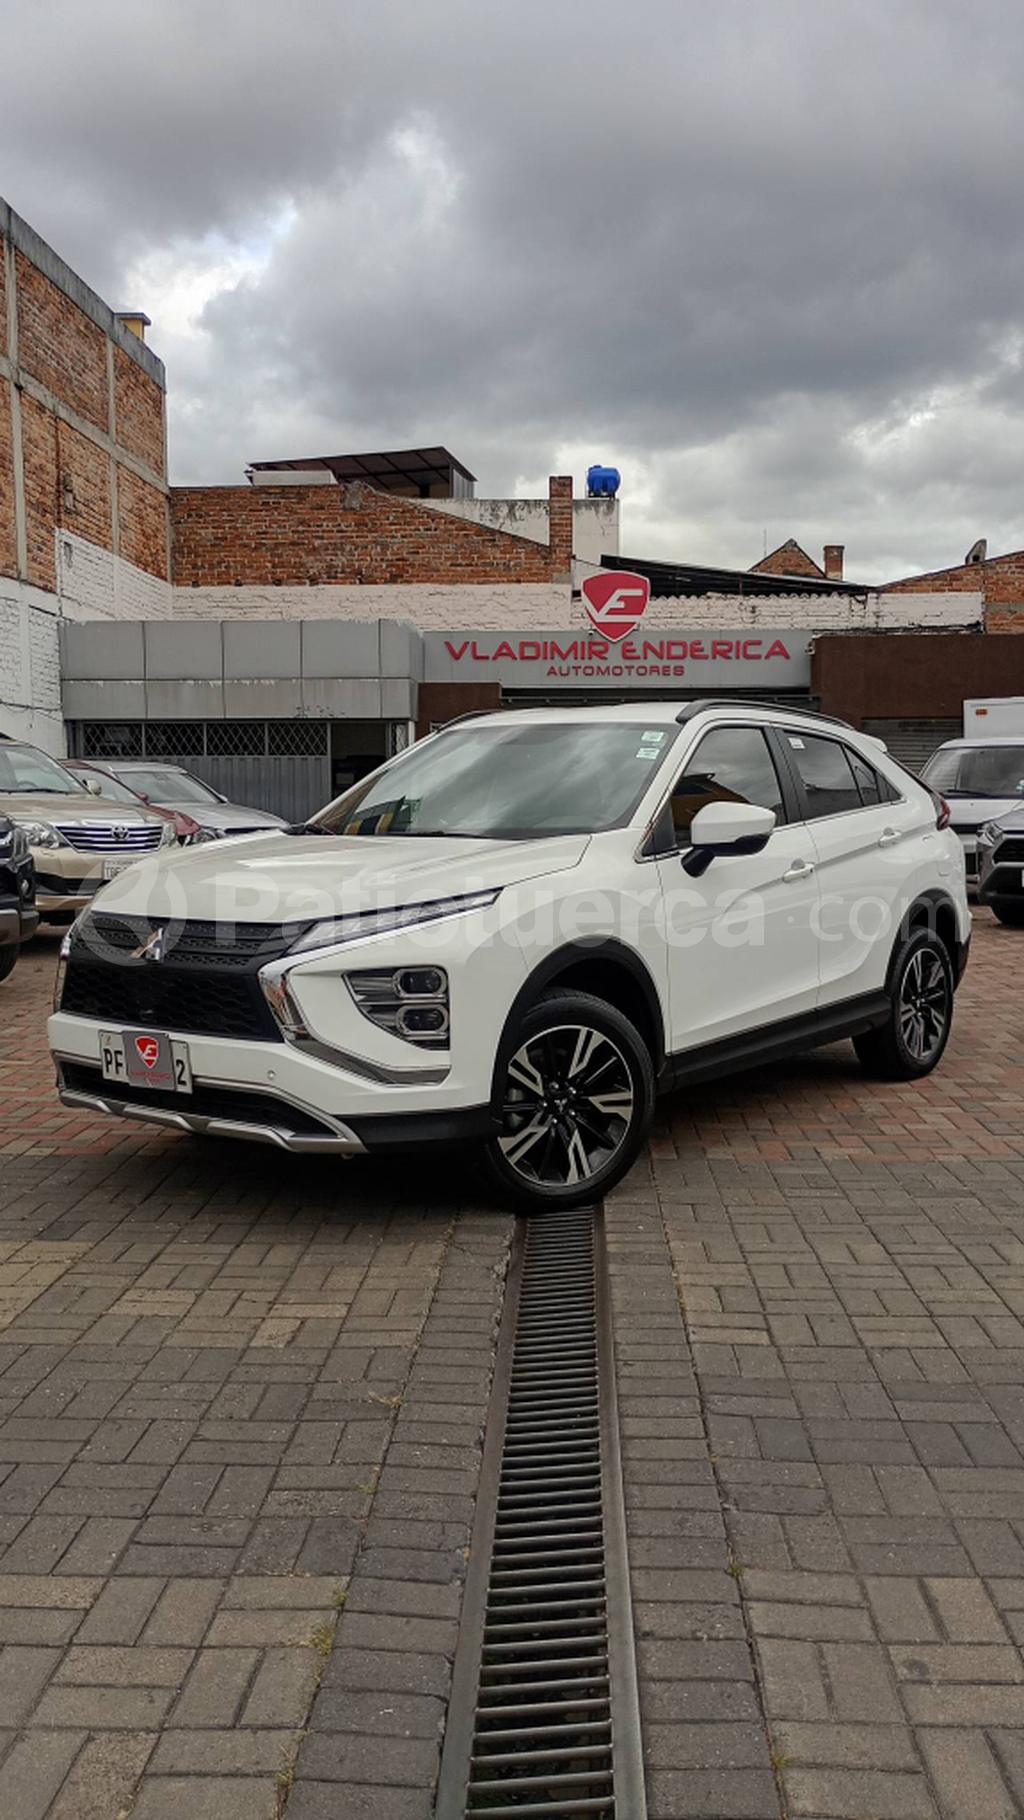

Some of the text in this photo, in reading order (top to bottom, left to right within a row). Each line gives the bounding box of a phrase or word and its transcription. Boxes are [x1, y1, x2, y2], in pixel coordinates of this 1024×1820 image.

[444, 640, 790, 660] VLADIMIR ENDERICA
[547, 665, 685, 677] AUTOMOTORES
[103, 1048, 187, 1086] PF 2
